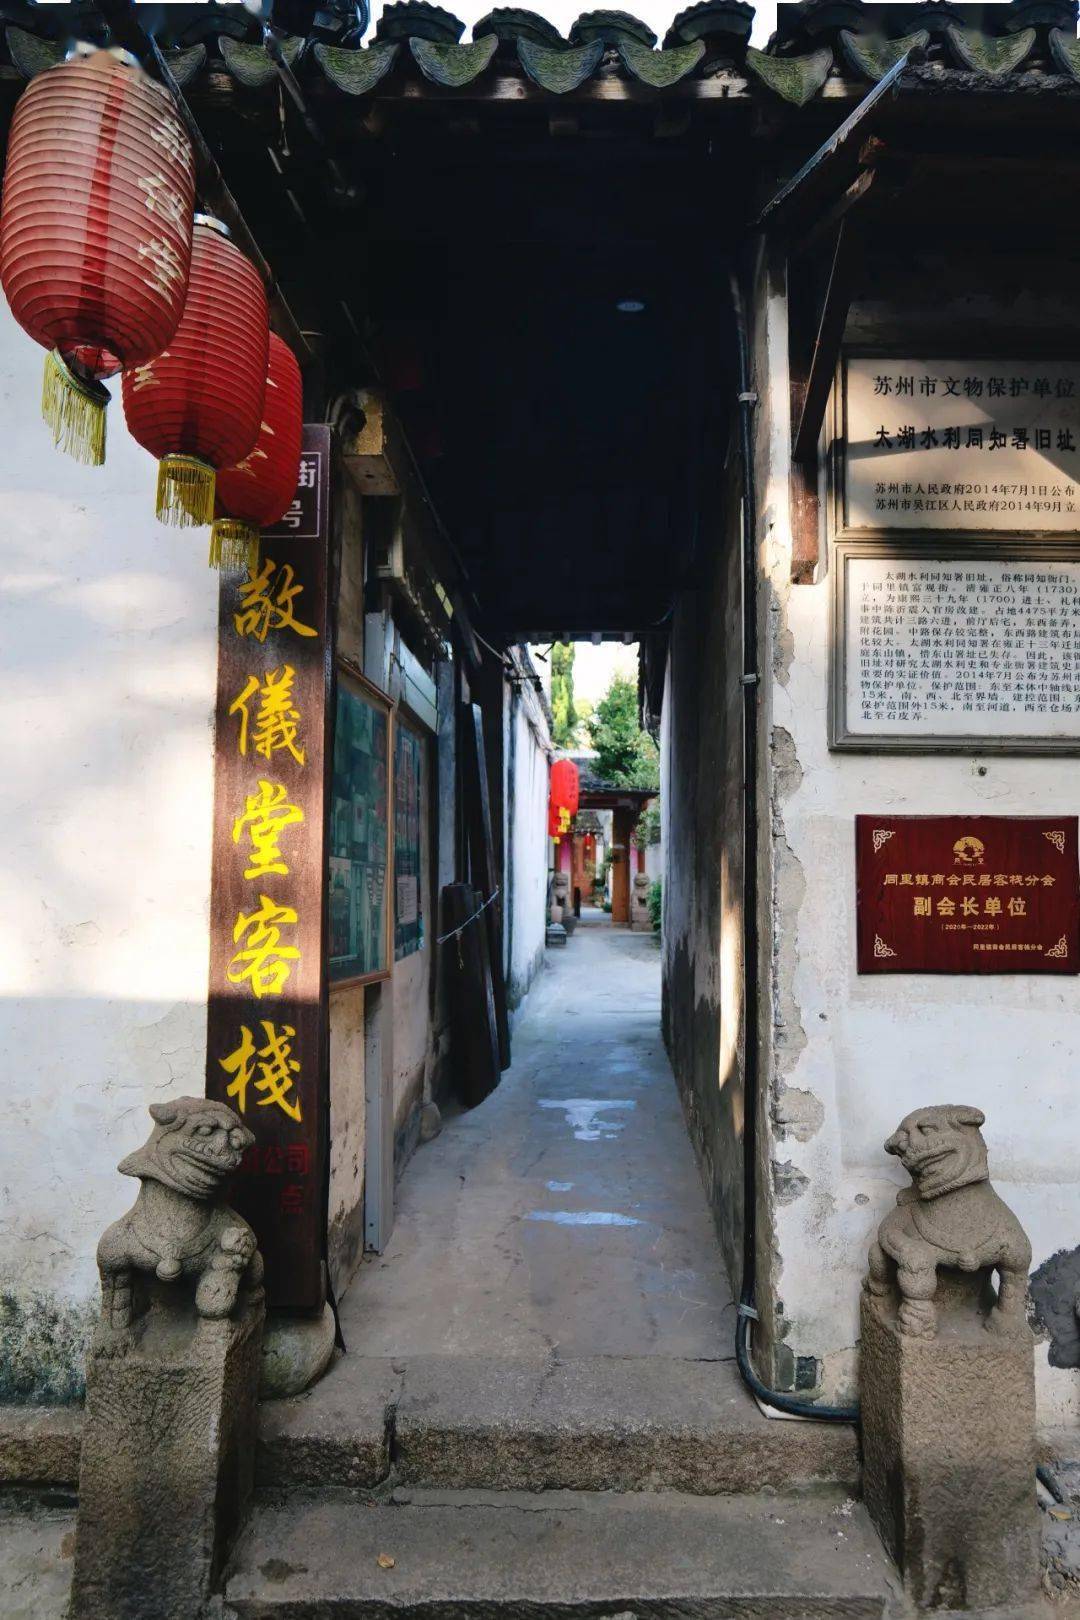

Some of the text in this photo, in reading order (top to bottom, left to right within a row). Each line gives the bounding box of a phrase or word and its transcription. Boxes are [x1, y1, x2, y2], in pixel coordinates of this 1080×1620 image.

[873, 375, 1076, 398] 苏州市文物保护单位
[873, 425, 1077, 452] 太湖水利同知署旧址
[875, 482, 1076, 497] 苏州市人民政府2014年7月1日公布
[875, 498, 1077, 513] 苏州市吴江区人民政府2014年9月立
[883, 874, 1056, 887] 同里镇商会民居客栈分会
[913, 896, 1027, 917] 副会长单位
